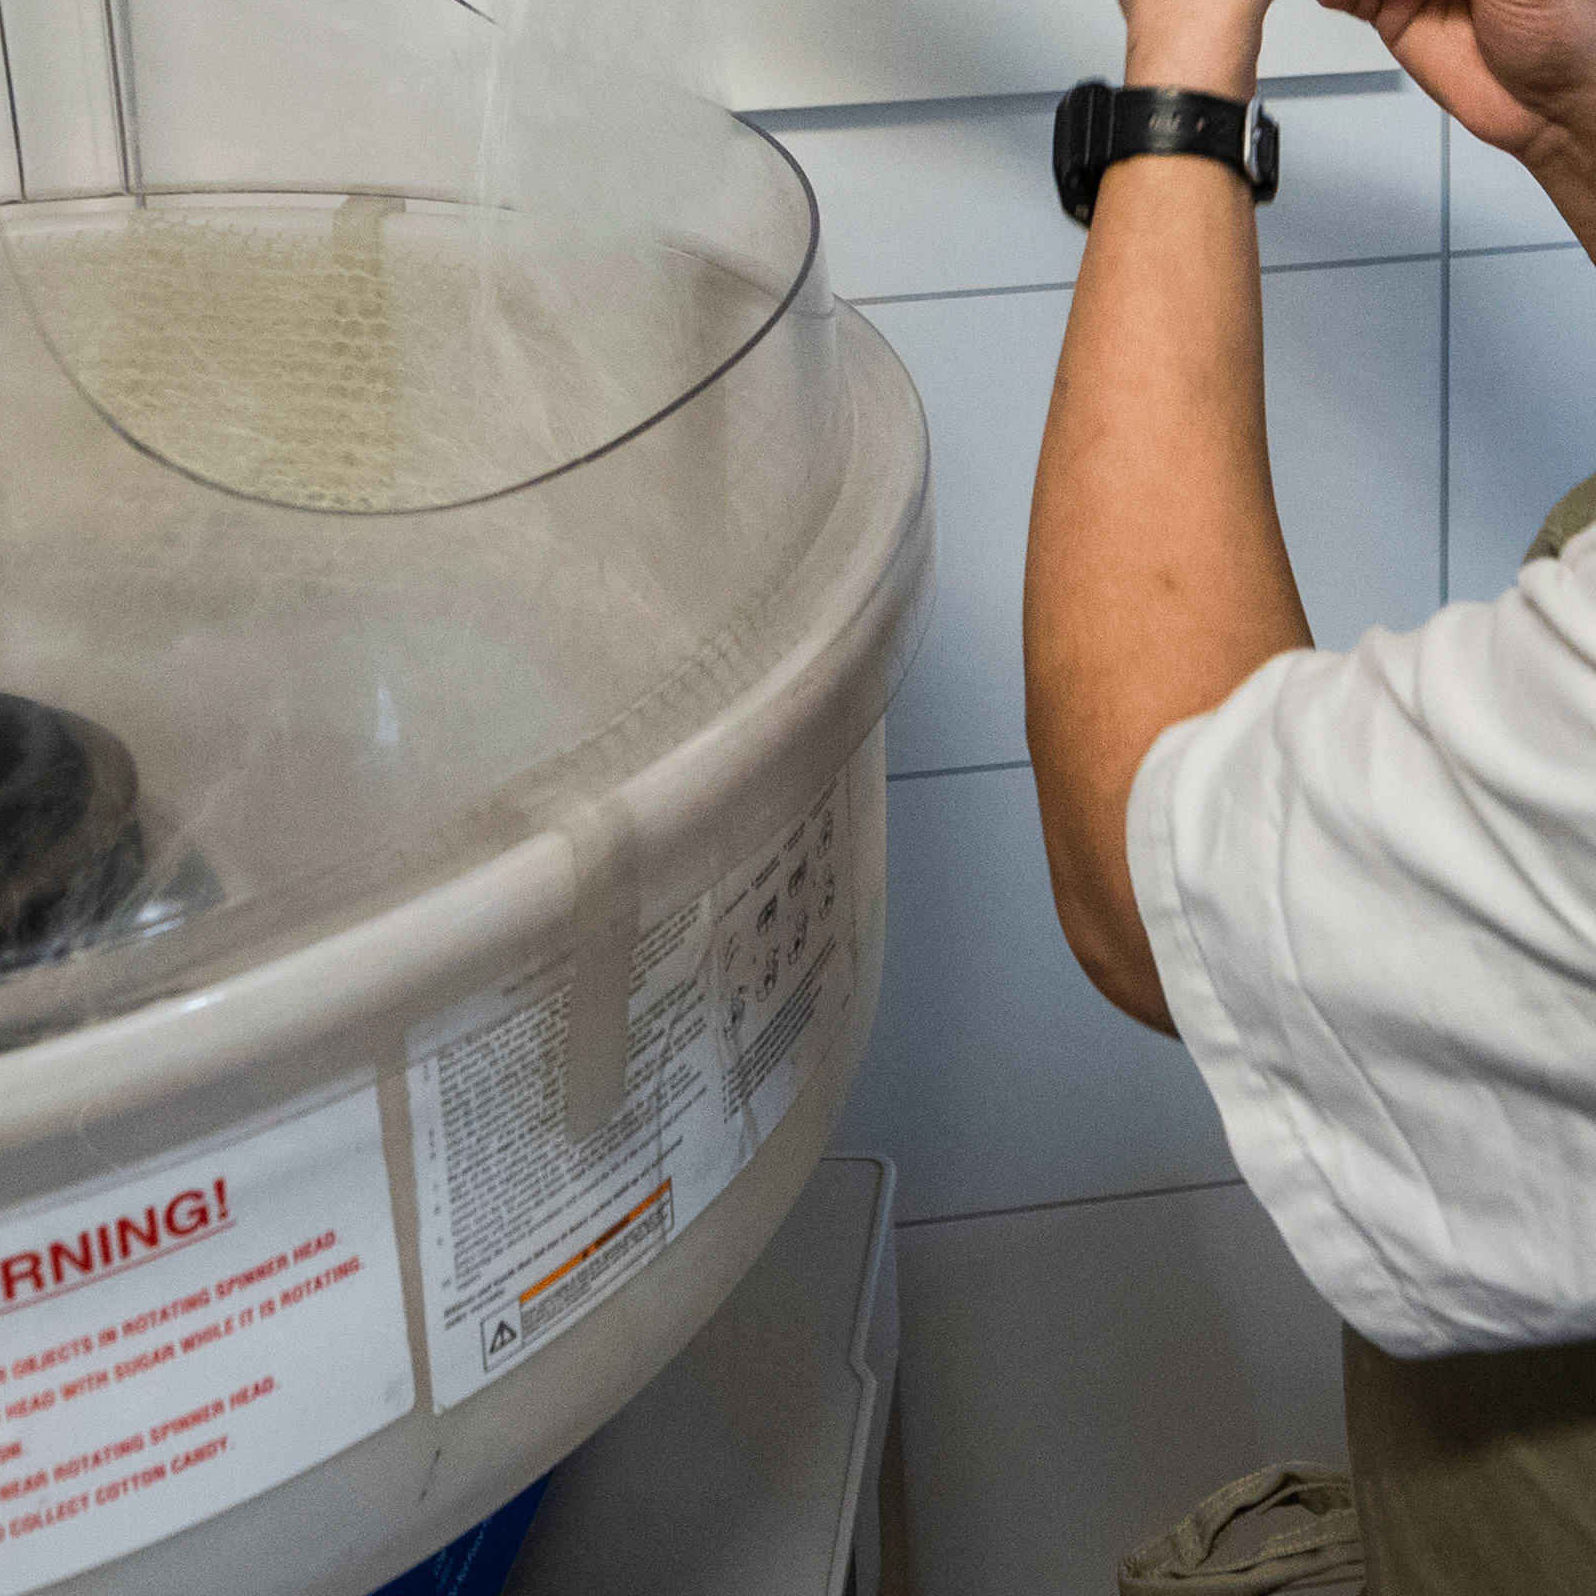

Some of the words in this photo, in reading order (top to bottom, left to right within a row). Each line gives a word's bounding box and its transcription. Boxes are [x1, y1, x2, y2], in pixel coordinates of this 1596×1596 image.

[5, 1391, 56, 1418] HEAD
[60, 1371, 109, 1401] WITH
[114, 1343, 175, 1380] SUGAR
[180, 1316, 234, 1353] WHILE
[238, 1304, 255, 1328] IT
[259, 1296, 277, 1320] IS
[12, 1336, 93, 1379] OBJECTS
[98, 1326, 118, 1349] IN
[121, 1288, 212, 1339] ROTATING
[215, 1254, 289, 1299] SPINNER
[53, 1434, 144, 1482] ROTATING
[149, 1399, 225, 1444] SPINNER
[9, 1492, 90, 1537] COLLECT
[94, 1463, 168, 1506] COTTON
